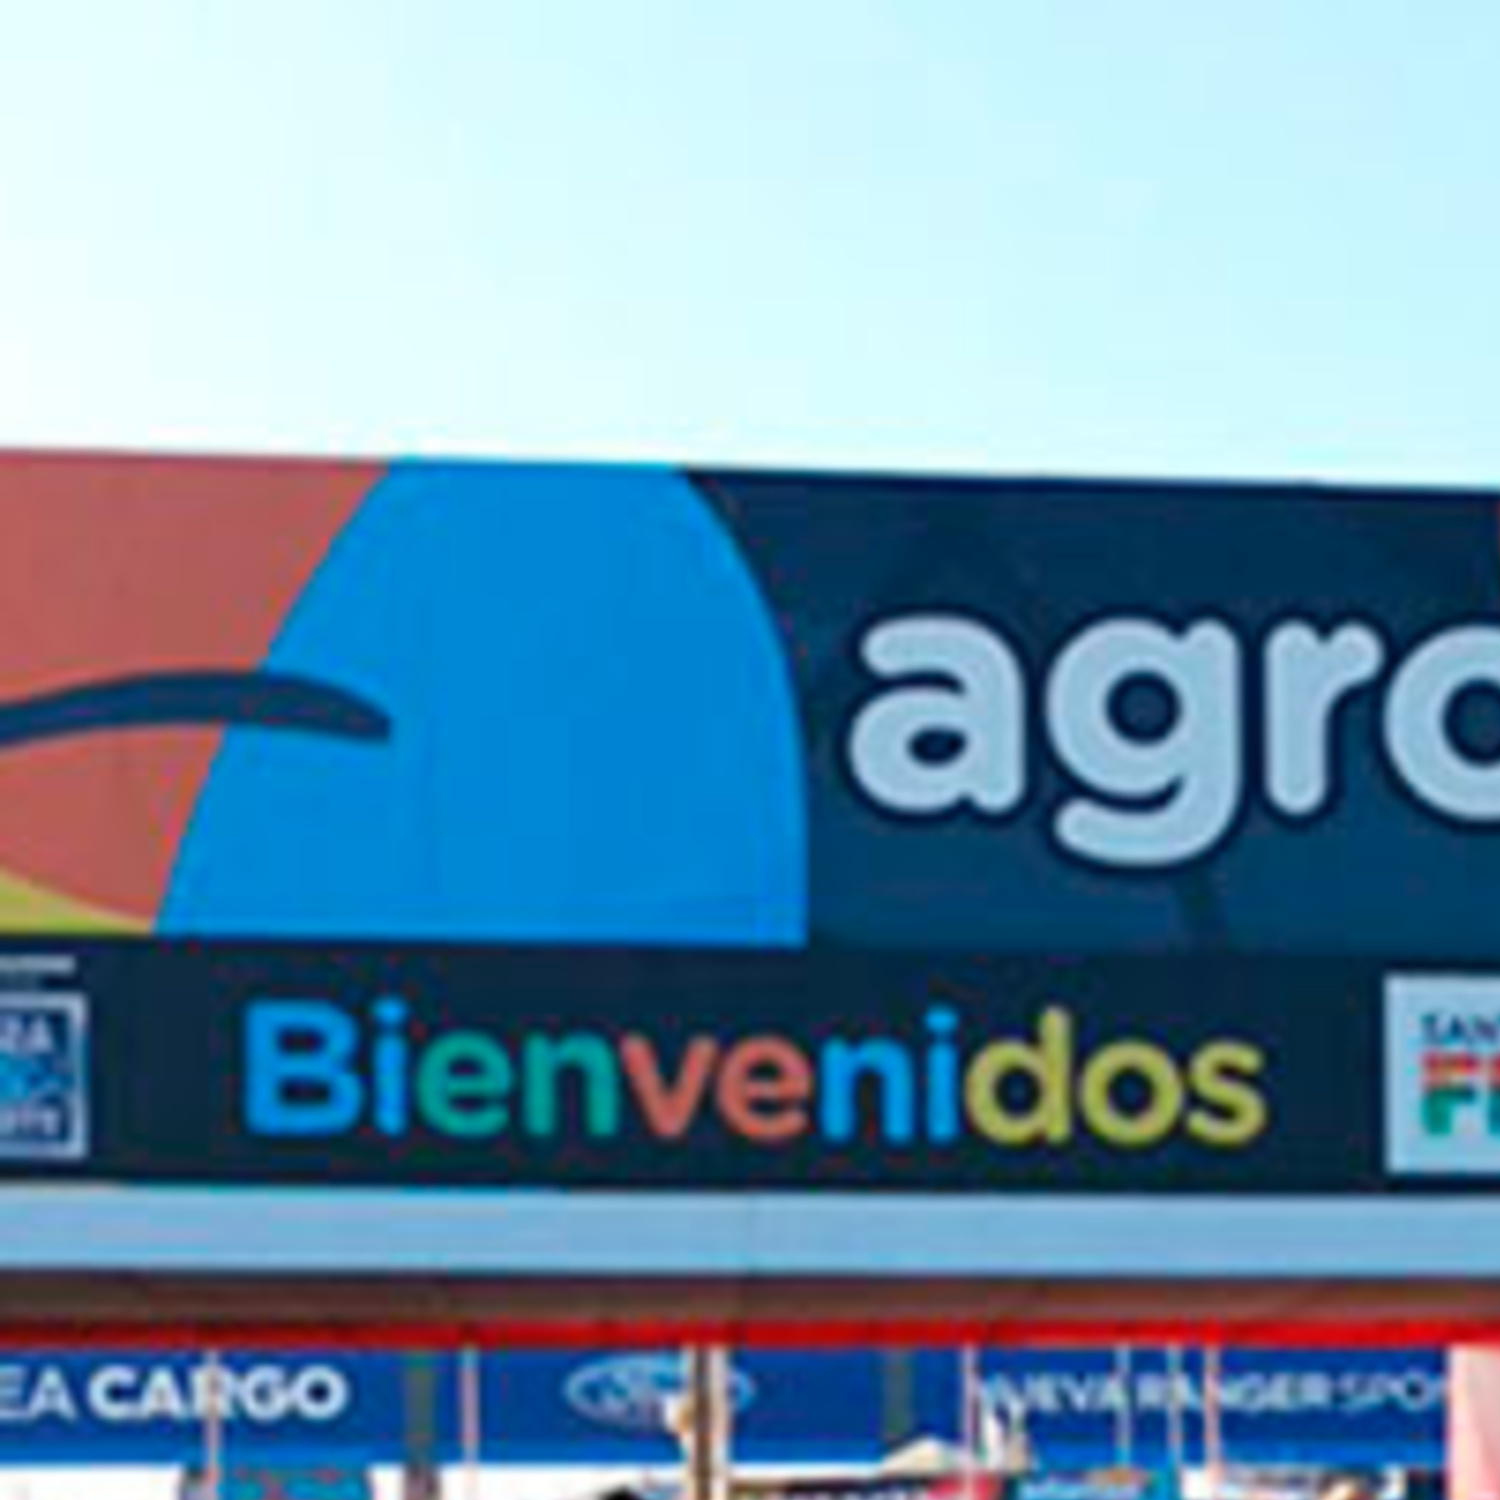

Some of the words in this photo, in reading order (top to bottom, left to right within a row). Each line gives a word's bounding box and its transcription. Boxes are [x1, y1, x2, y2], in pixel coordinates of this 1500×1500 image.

[244, 998, 1266, 1142] Bienvenidos
[88, 1364, 350, 1420] CARGO
[1338, 1370, 1448, 1416] SPO
